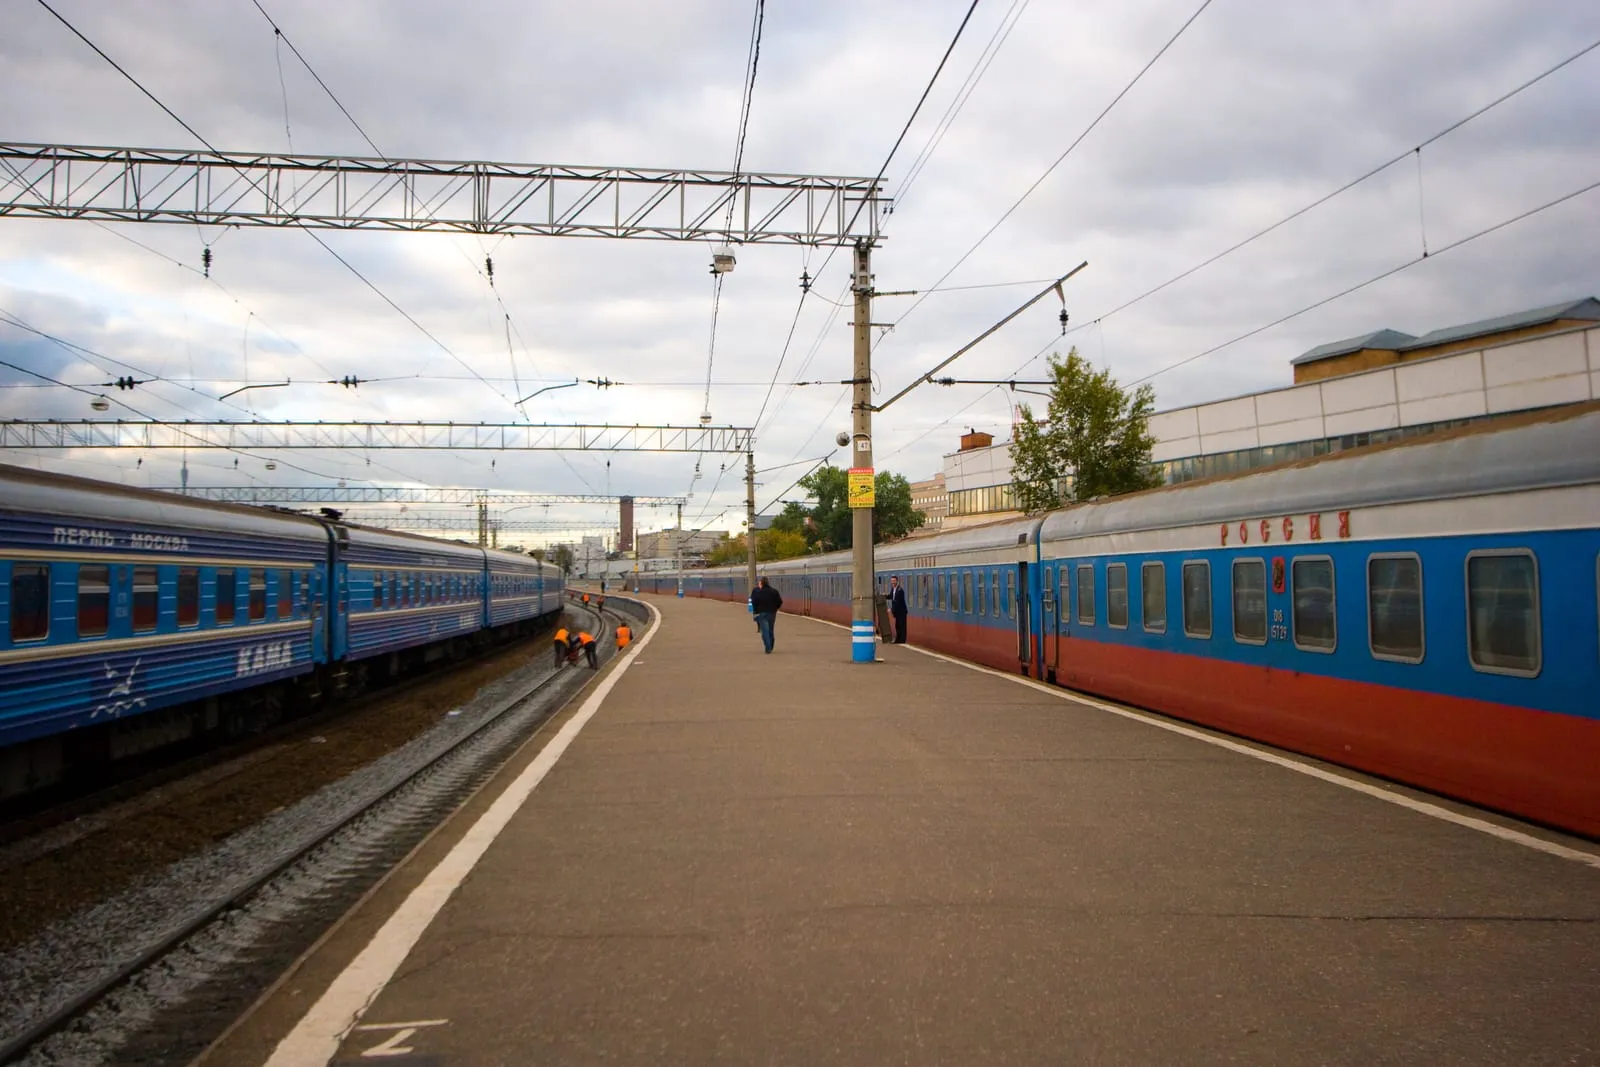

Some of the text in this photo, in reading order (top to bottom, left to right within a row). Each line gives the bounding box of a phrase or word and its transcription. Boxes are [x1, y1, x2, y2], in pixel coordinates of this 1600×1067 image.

[53, 527, 115, 547] ПЕРМЬ
[130, 532, 189, 552] МОСКВА
[1220, 510, 1351, 546] РОССИЯ
[236, 640, 292, 678] КАМА
